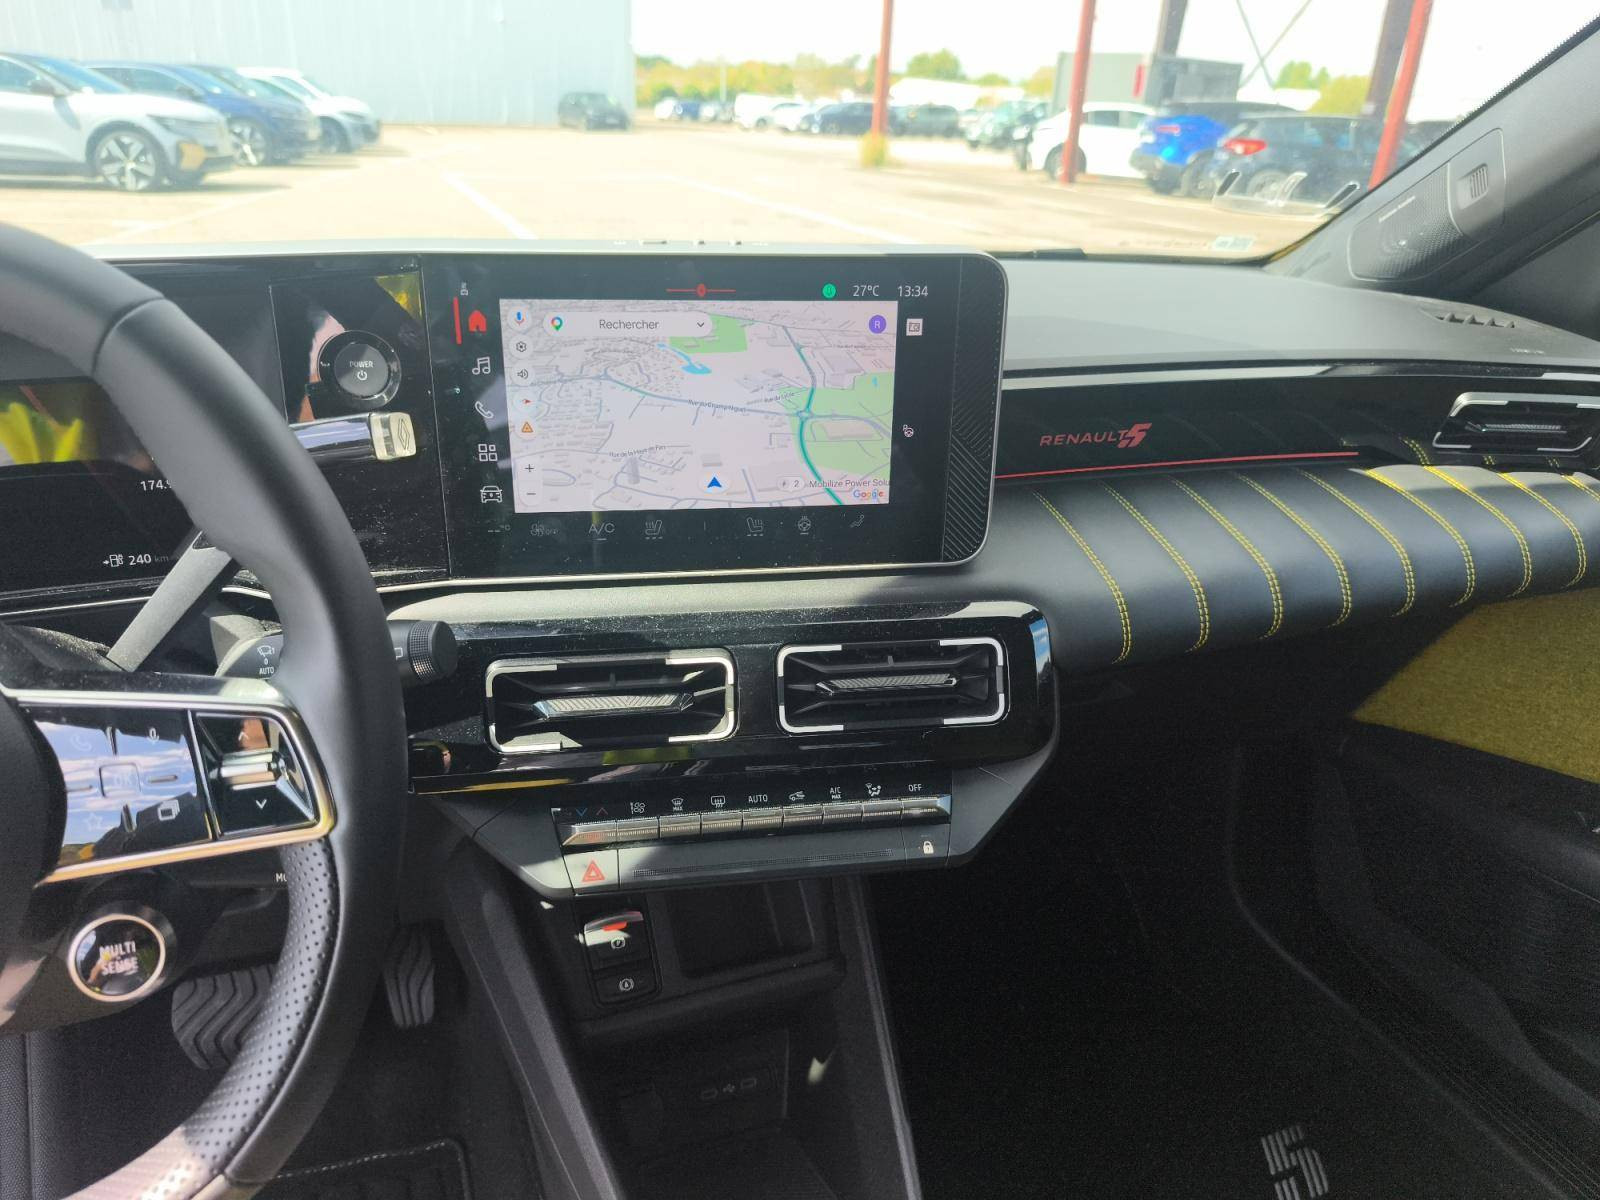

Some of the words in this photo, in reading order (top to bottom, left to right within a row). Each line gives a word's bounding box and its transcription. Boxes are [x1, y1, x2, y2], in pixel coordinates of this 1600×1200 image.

[897, 284, 929, 297] 13:34
[599, 319, 659, 330] Rechercher
[874, 320, 881, 329] R
[349, 360, 374, 369] POWER
[1040, 429, 1128, 446] RENAULT
[793, 480, 800, 488] 2
[809, 479, 843, 488] Mobilize
[845, 479, 870, 488] Power
[853, 489, 884, 500] Google
[588, 522, 615, 534] A/C
[128, 553, 152, 566] 240
[258, 666, 275, 675] AUTO
[829, 786, 841, 795] A/C
[908, 783, 922, 792] OFF
[748, 794, 768, 804] AUTO
[99, 940, 137, 959] MULTI
